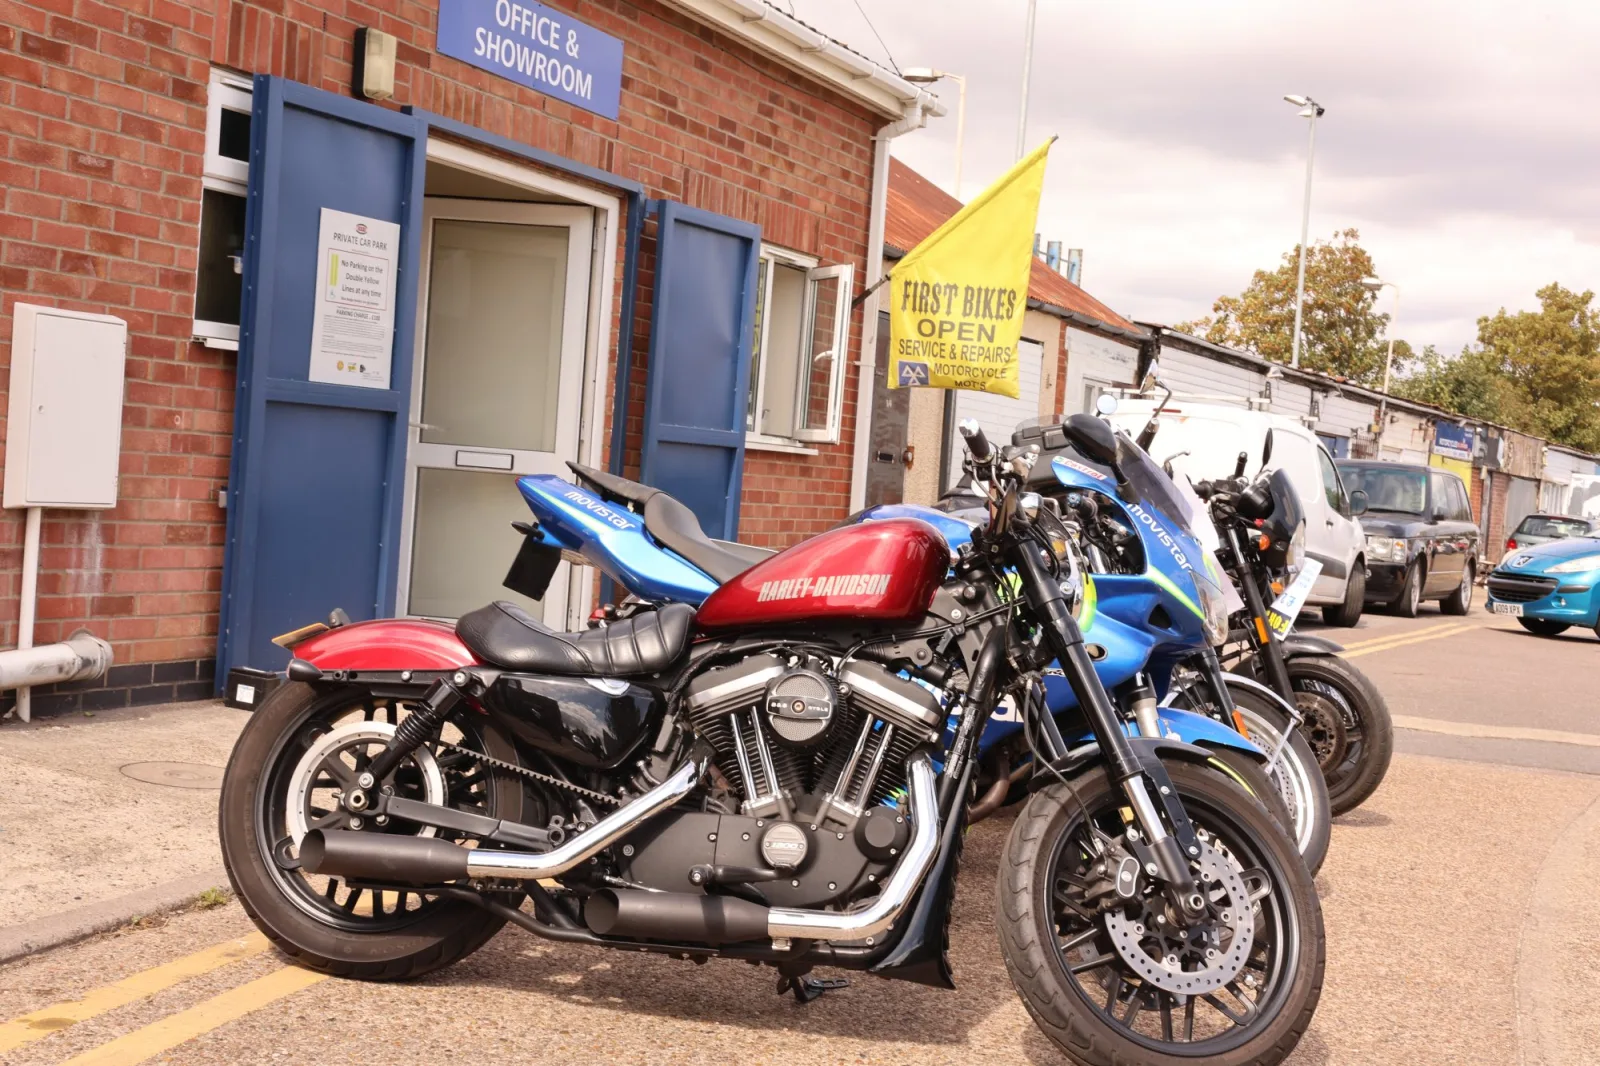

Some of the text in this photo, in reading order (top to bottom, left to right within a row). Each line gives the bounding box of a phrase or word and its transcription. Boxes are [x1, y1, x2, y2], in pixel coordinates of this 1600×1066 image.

[496, 0, 580, 59] OFFICE &
[474, 27, 593, 100] SHOWROOM
[333, 232, 388, 251] PRIVATE CAR PARK
[341, 260, 349, 268] No
[350, 260, 368, 272] Parking
[375, 266, 384, 274] the
[345, 272, 380, 285] Double Yellow
[341, 284, 355, 293] Lines
[361, 289, 370, 297] any
[370, 290, 382, 298] time
[901, 280, 1017, 321] FIRST BIKES
[917, 318, 996, 343] OPEN
[898, 339, 1012, 364] SERVICE & REPAIRS
[933, 362, 1008, 380] MOTORCYCLE
[954, 379, 987, 392] MOT'S
[564, 491, 636, 530] movistar
[1126, 503, 1193, 573] movistar
[757, 574, 891, 602] HARLEY-DAVIDSON
